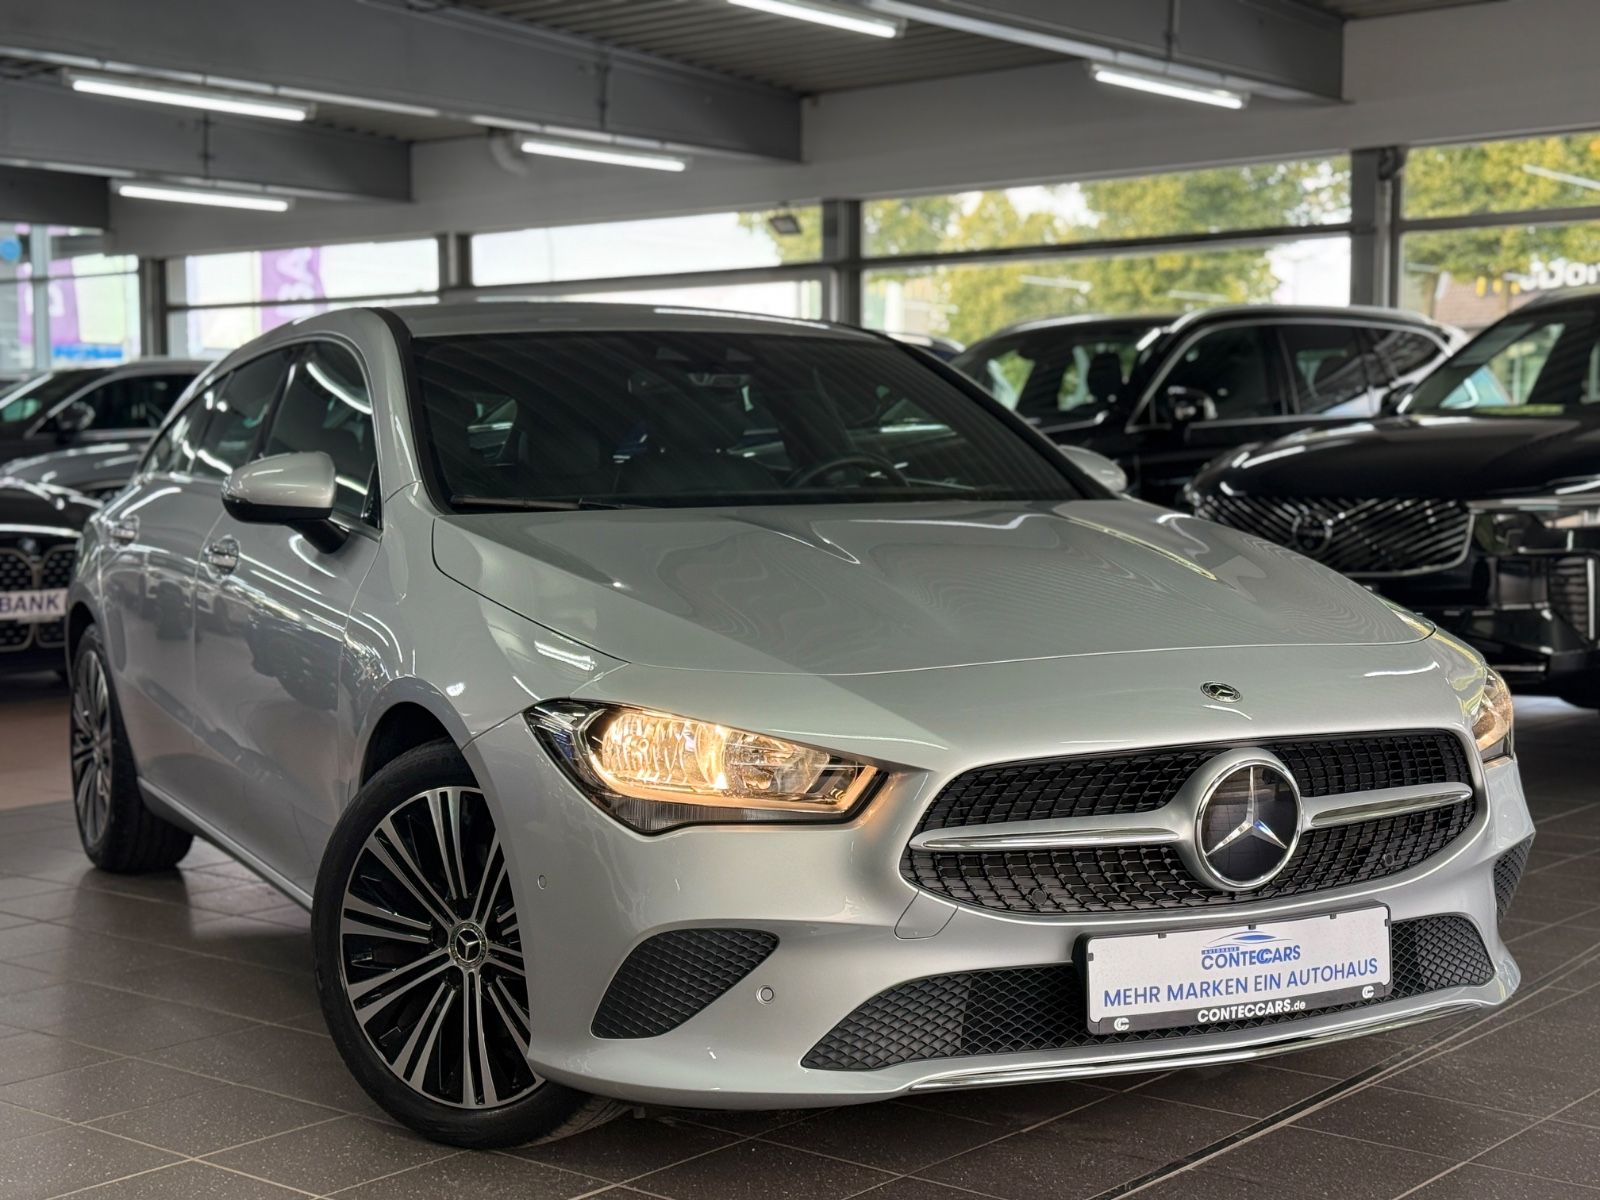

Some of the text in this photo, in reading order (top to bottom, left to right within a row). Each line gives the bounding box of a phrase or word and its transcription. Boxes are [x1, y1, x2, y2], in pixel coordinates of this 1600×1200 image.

[1103, 958, 1378, 1008] MEHR MARKEN EIN AUTOHAUS
[1197, 998, 1306, 1023] CONTECCARS.de
